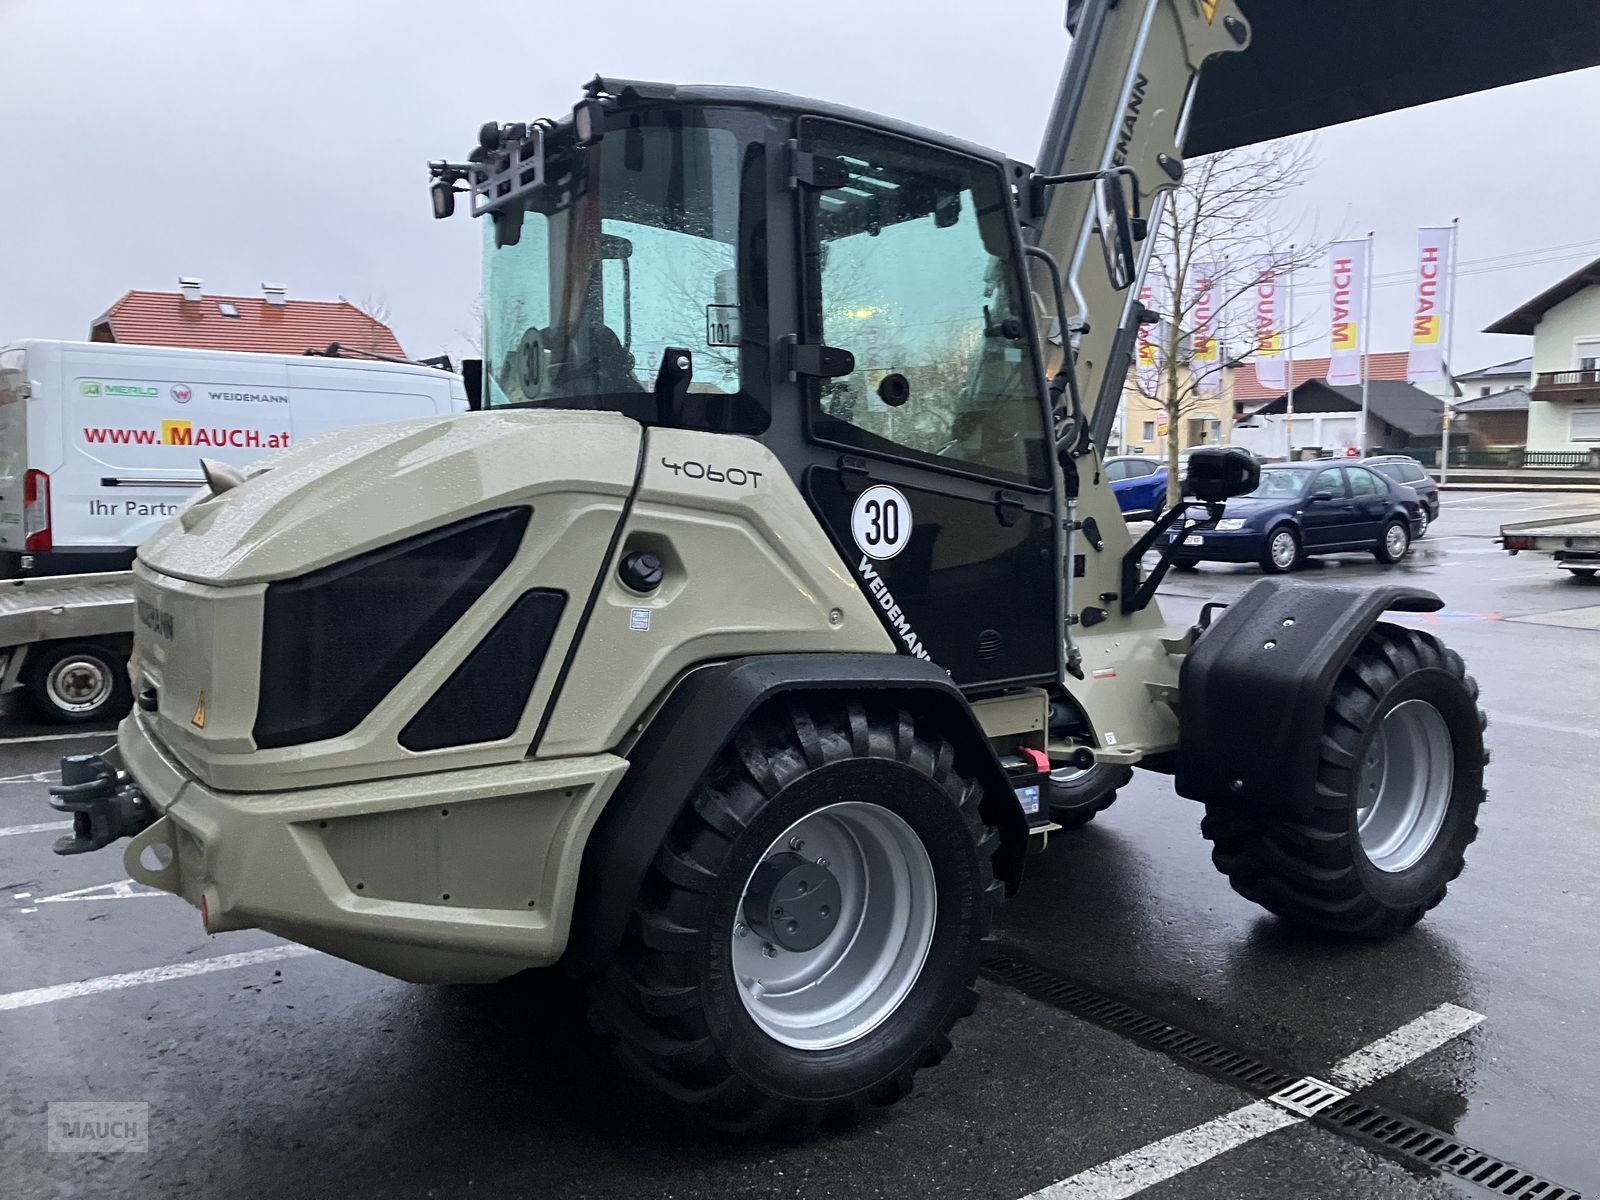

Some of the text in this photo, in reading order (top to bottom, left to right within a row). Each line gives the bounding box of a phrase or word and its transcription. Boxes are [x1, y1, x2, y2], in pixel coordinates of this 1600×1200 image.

[710, 323, 730, 343] 101
[208, 391, 289, 404] WEIDEMANN
[661, 457, 762, 489] 4060T
[89, 500, 119, 516] Ihr
[864, 499, 899, 546] 30
[858, 555, 931, 662] WEIDEMAN
